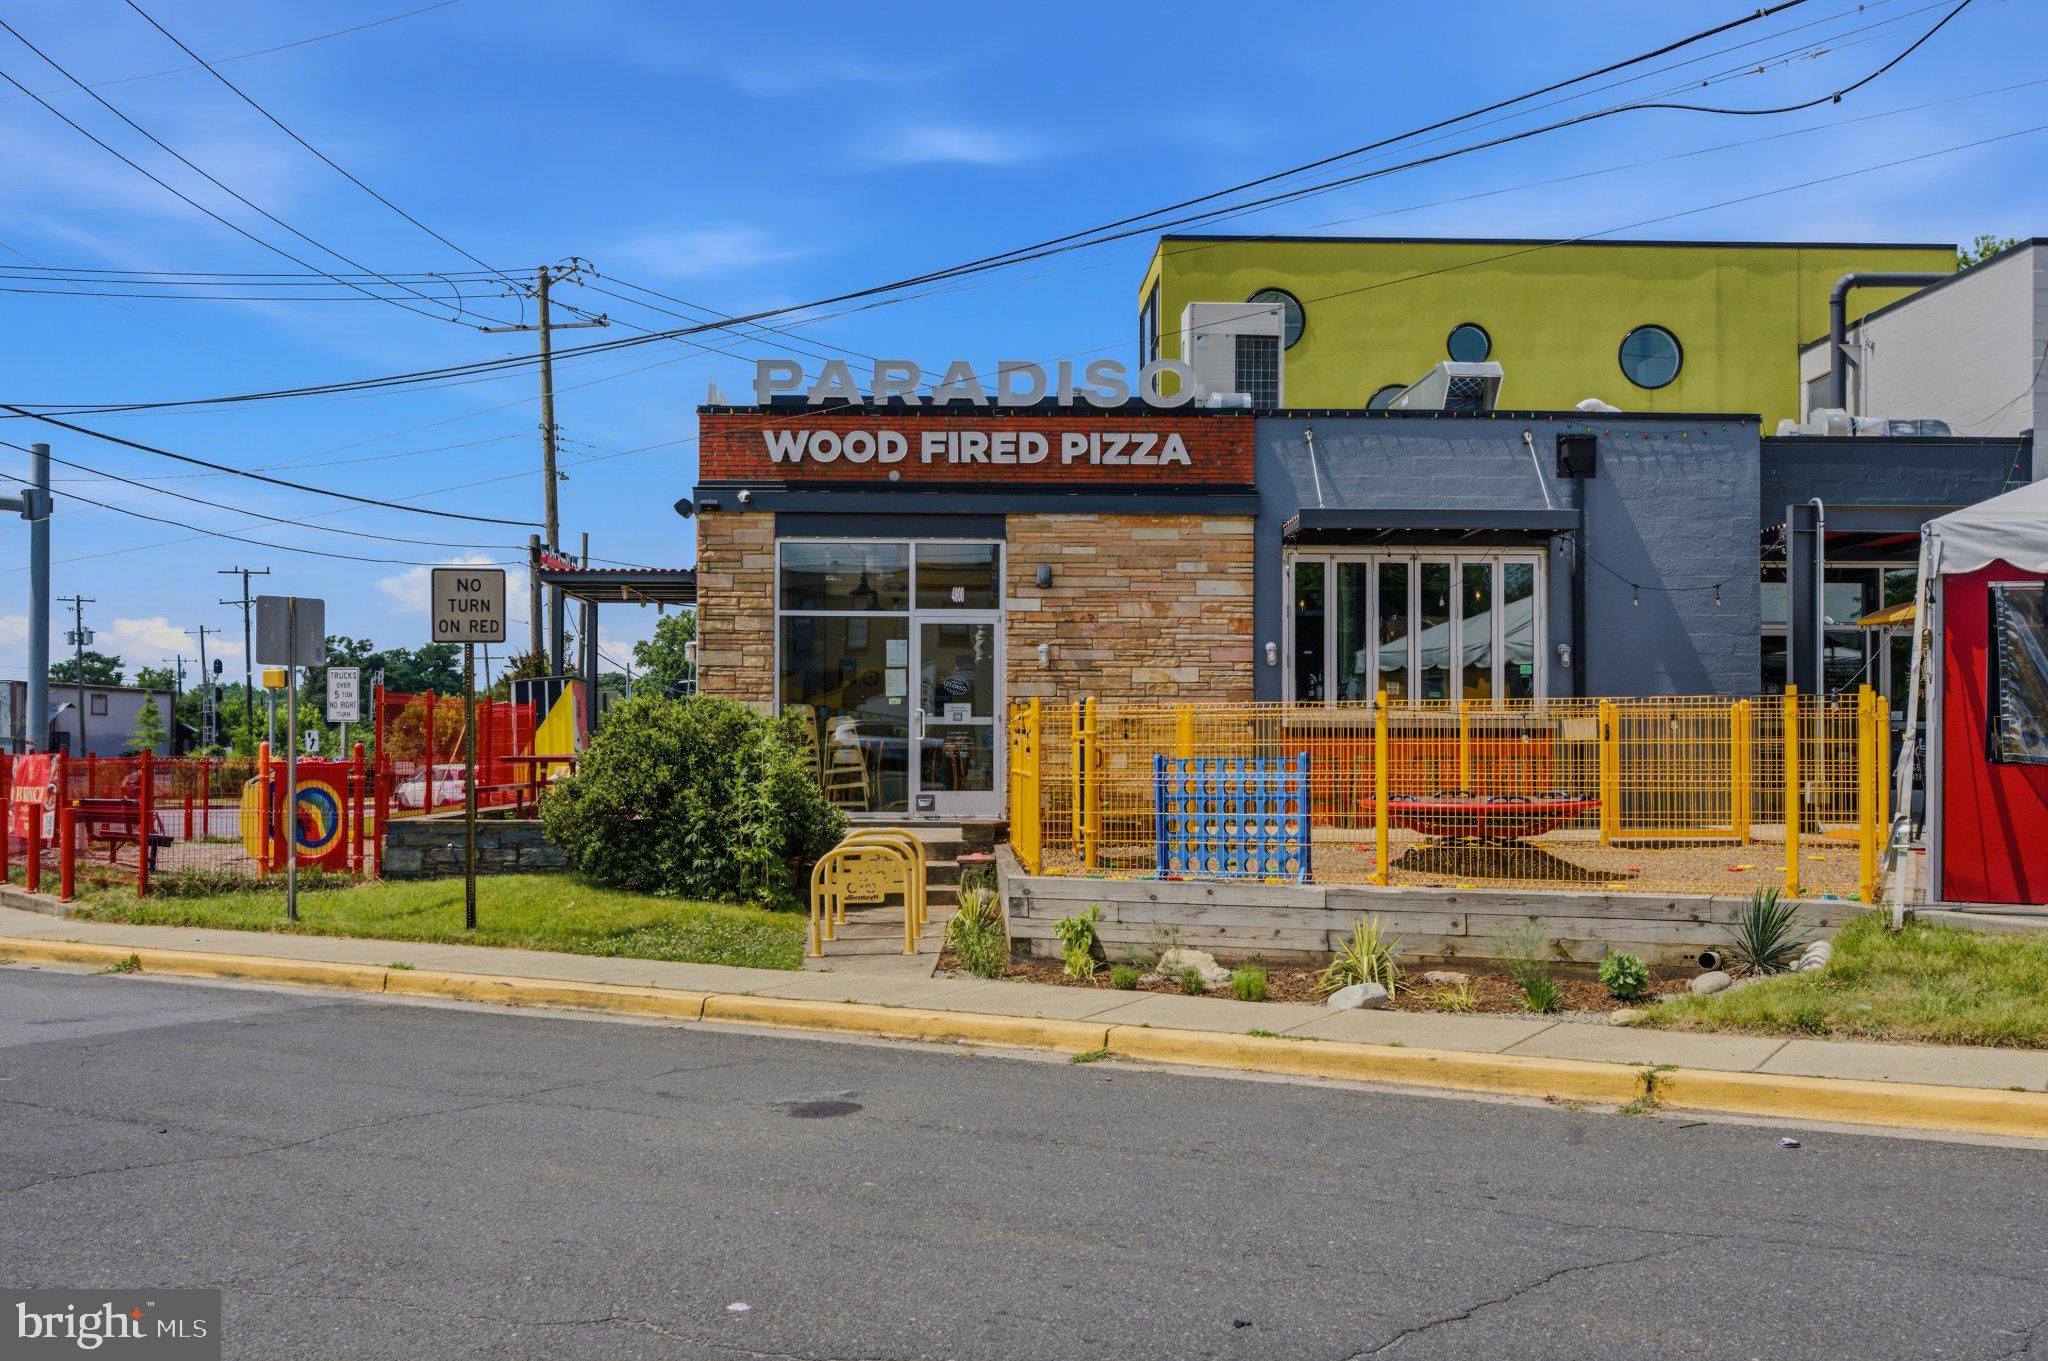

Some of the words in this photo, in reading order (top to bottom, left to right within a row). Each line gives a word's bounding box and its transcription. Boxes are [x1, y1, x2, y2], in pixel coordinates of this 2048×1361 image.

[753, 359, 1198, 409] PARADISO
[762, 430, 908, 464] WOOD
[921, 431, 1049, 465] FIRED
[1061, 432, 1192, 466] PIZZA
[457, 578, 482, 593] NO
[448, 598, 491, 613] TURN
[438, 619, 460, 634] ON
[469, 619, 500, 634] RED
[330, 671, 357, 680] TRUCKS
[336, 681, 351, 689] OVER
[334, 690, 340, 699] 5
[329, 701, 338, 709] NO
[340, 701, 357, 709] RIGHT
